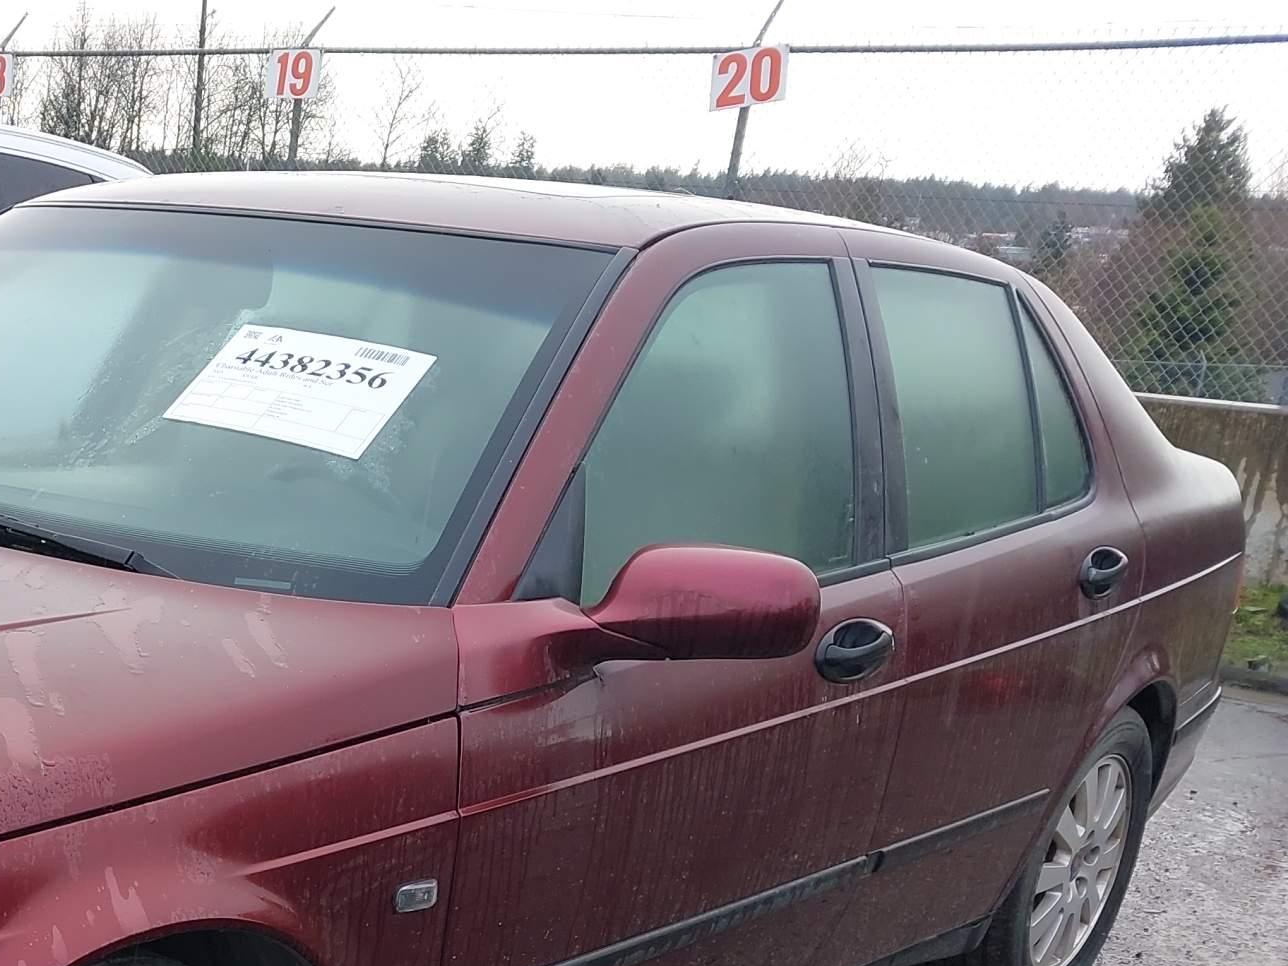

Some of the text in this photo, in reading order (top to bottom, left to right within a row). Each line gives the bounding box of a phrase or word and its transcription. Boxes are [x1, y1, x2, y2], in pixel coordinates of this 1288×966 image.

[276, 51, 313, 96] 19
[716, 47, 782, 107] 20
[235, 348, 395, 389] 44382356
